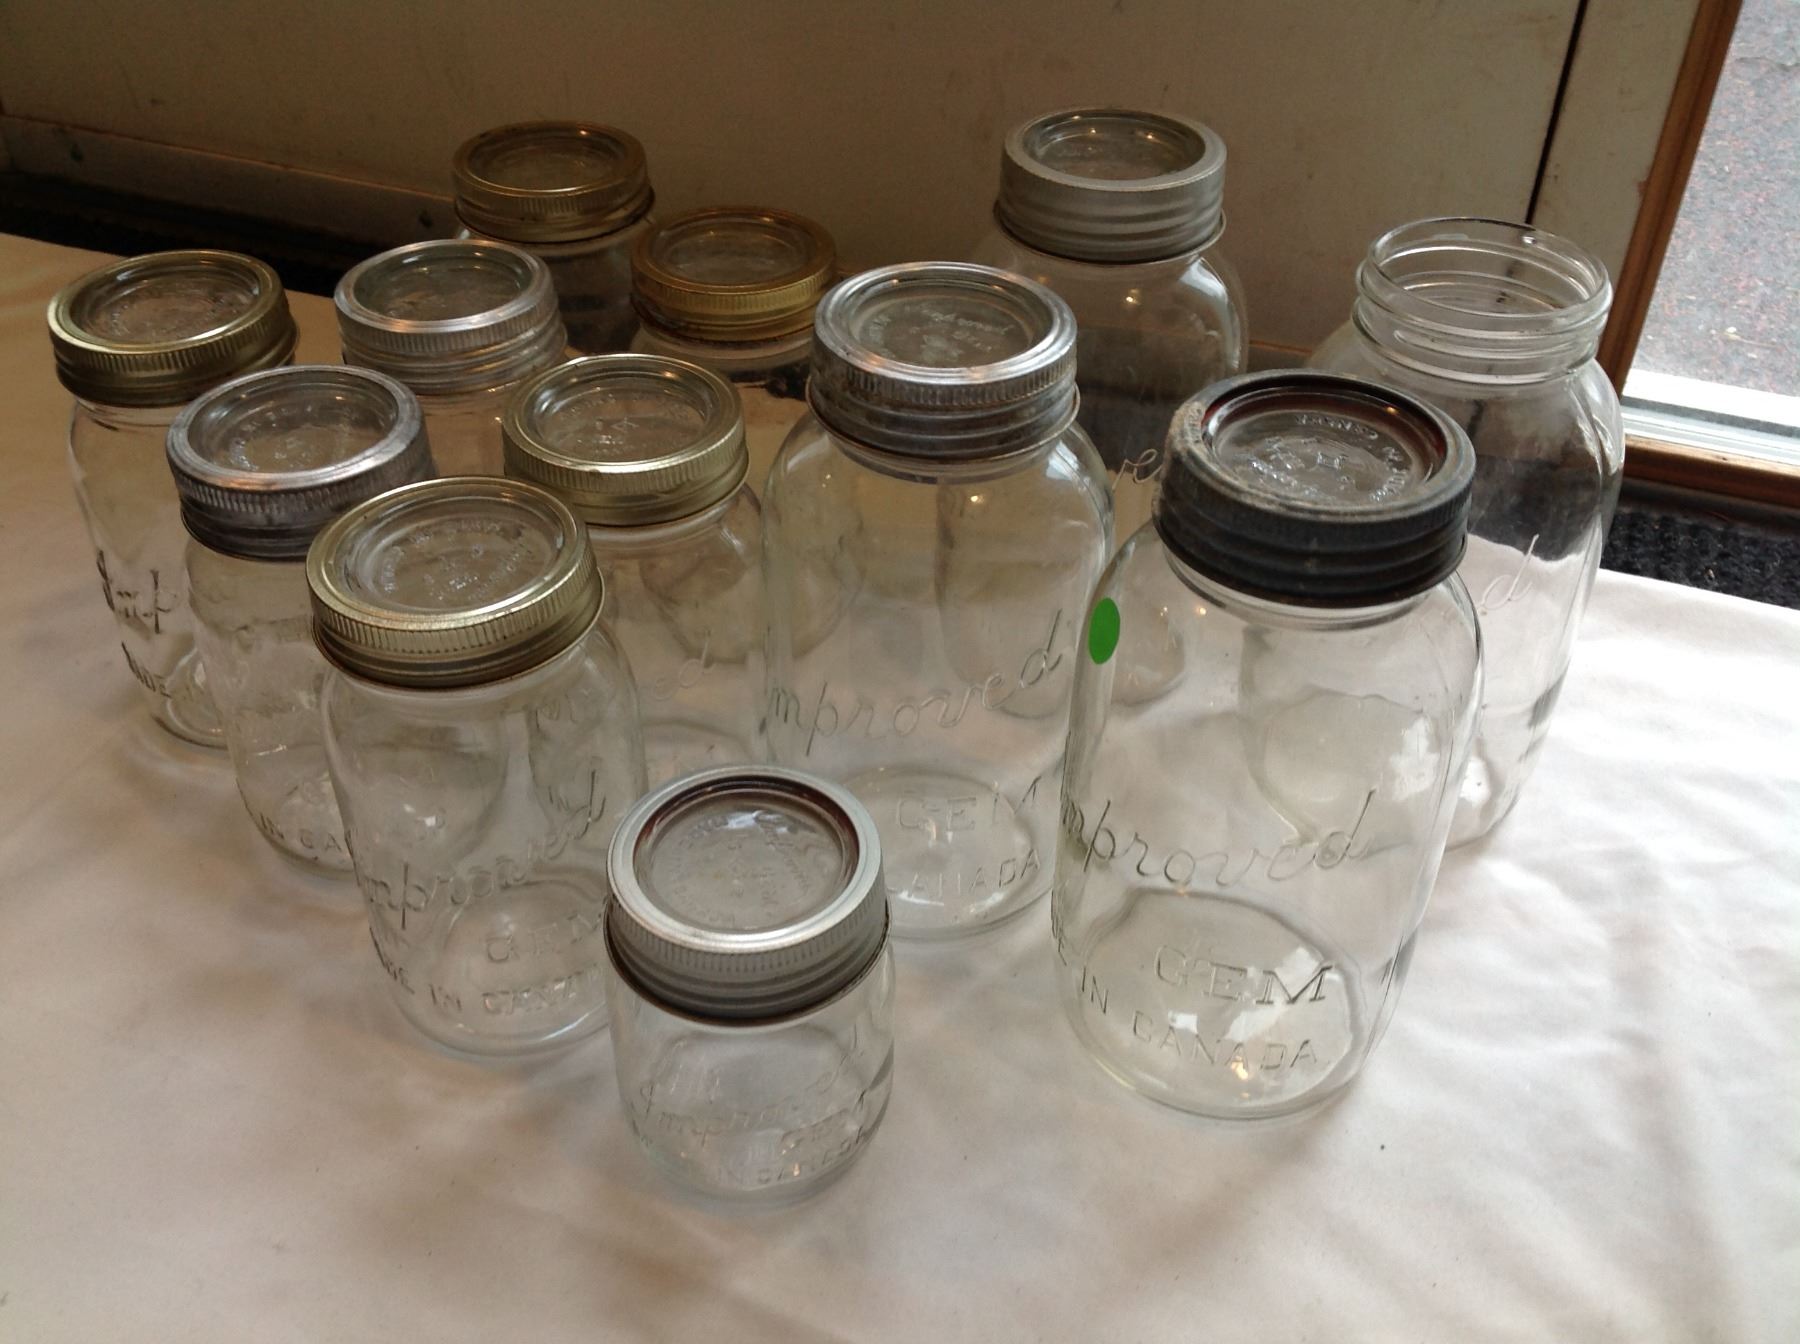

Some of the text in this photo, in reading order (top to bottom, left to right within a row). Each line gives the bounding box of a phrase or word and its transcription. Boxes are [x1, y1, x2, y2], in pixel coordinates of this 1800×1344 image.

[1153, 944, 1334, 1005] GEM
[1080, 966, 1318, 1071] IN CANADA
